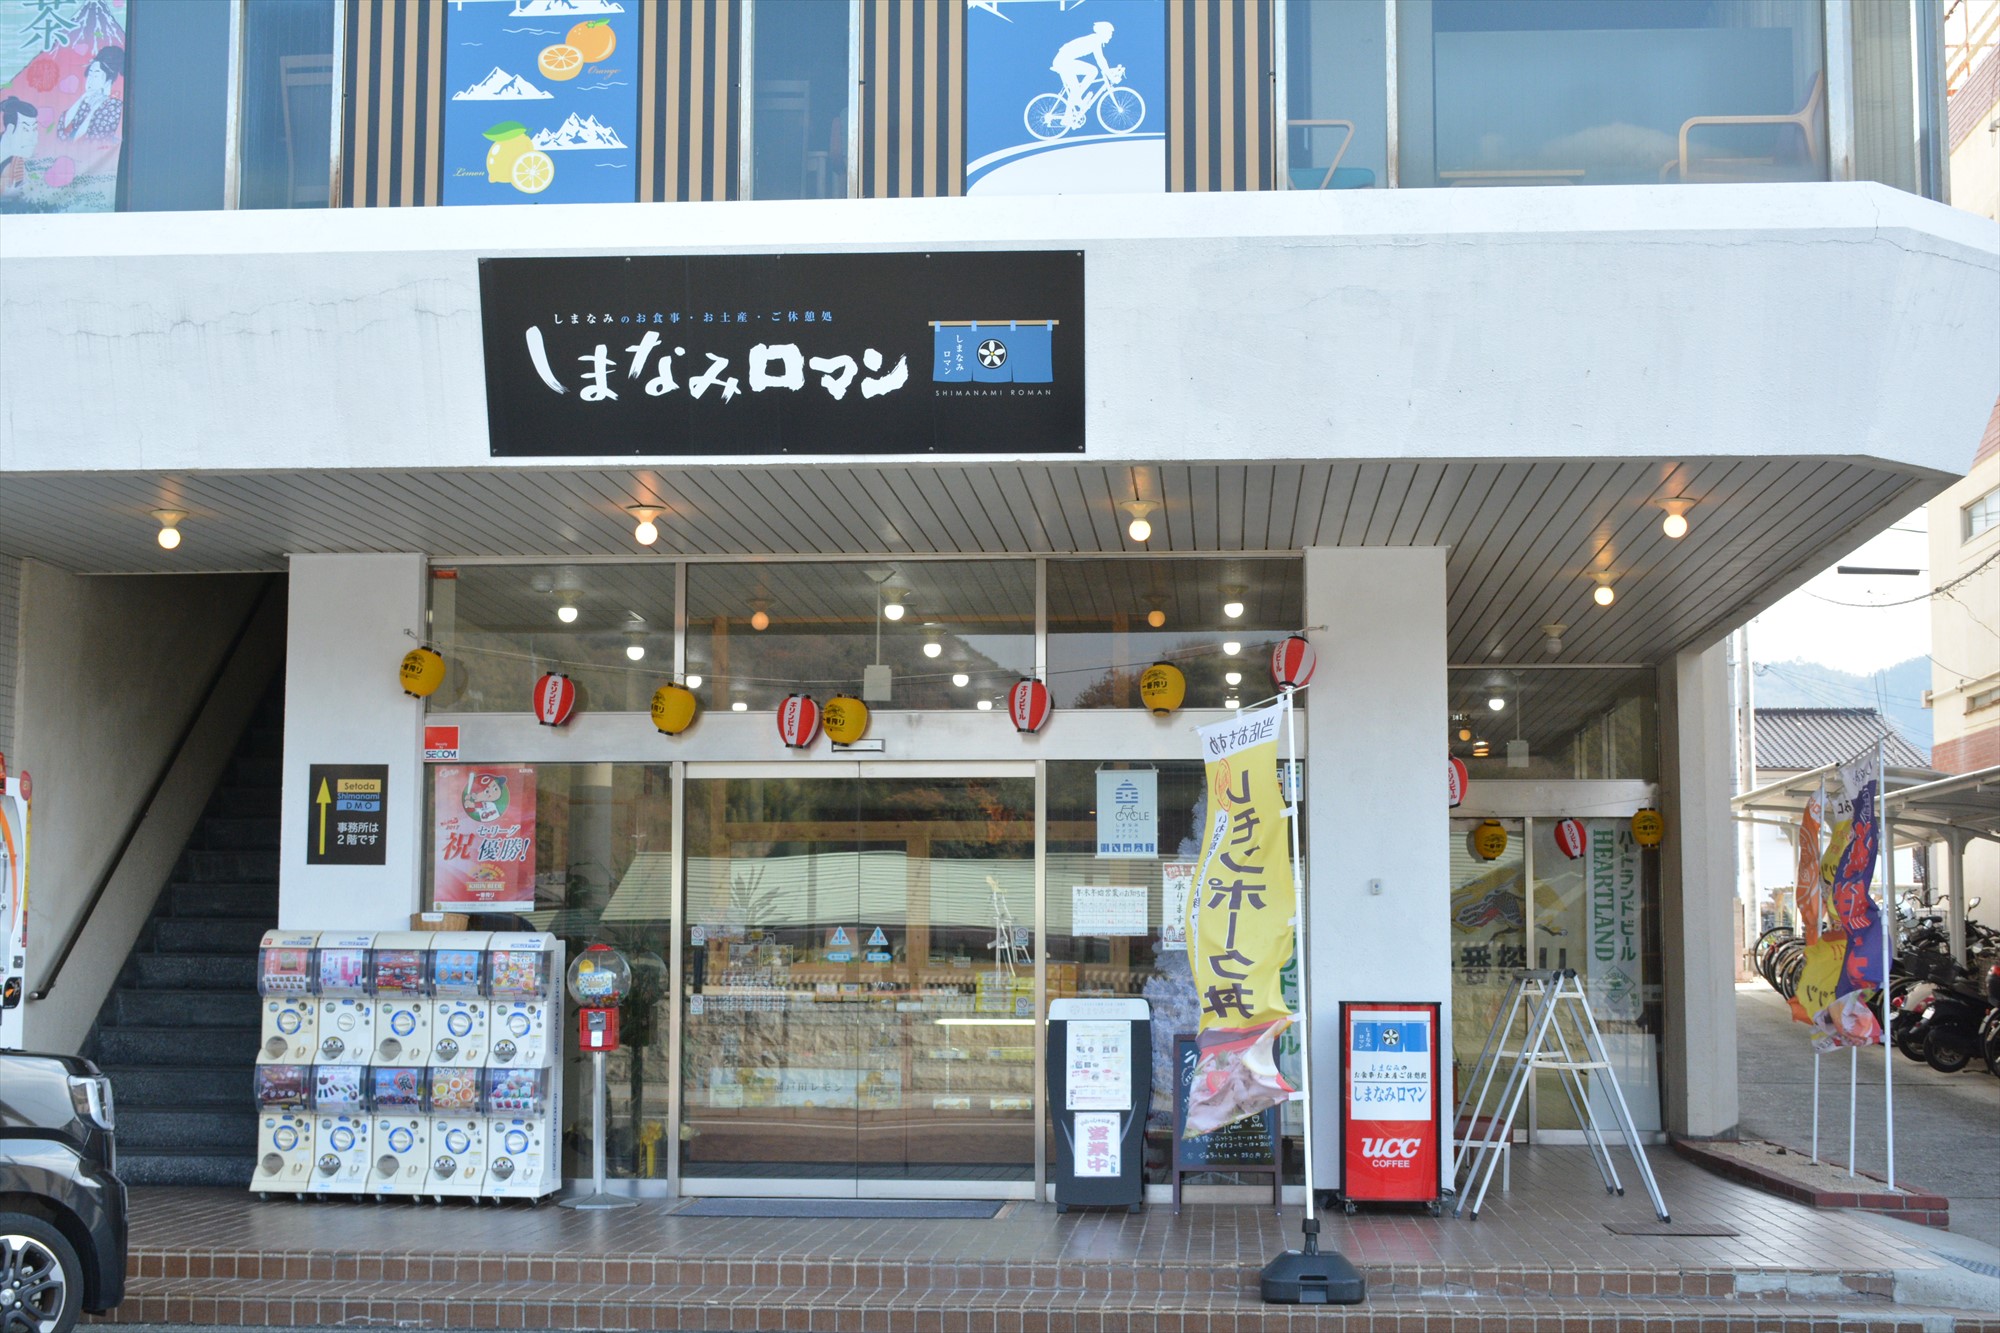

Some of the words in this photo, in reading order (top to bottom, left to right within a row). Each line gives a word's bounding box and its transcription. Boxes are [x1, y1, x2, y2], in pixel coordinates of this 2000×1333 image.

[587, 65, 621, 80] Orange
[453, 167, 485, 177] Lemon
[955, 333, 965, 372] しまなみ
[525, 325, 910, 404] しまなみロマン
[943, 350, 952, 375] ロマン
[935, 389, 1004, 397] SHIMANAMI
[1010, 388, 1053, 396] ROMAN
[1019, 685, 1029, 721] キリンビール
[787, 701, 797, 736] キリンビール
[425, 750, 457, 759] SECOM
[344, 782, 375, 790] Setoda
[337, 792, 380, 800] Shimanami
[1115, 810, 1150, 821] CYCLE
[337, 822, 379, 833] 事務所は
[337, 834, 378, 845] 2階です
[442, 832, 475, 860] 祝
[1593, 829, 1614, 962] HEARTLAND
[1619, 830, 1636, 961] ハートランドビール
[1354, 1085, 1428, 1103] しまなみロマン
[1087, 1125, 1109, 1173] 営業中
[1361, 1137, 1421, 1158] UCC
[1372, 1159, 1410, 1168] COFFEE
